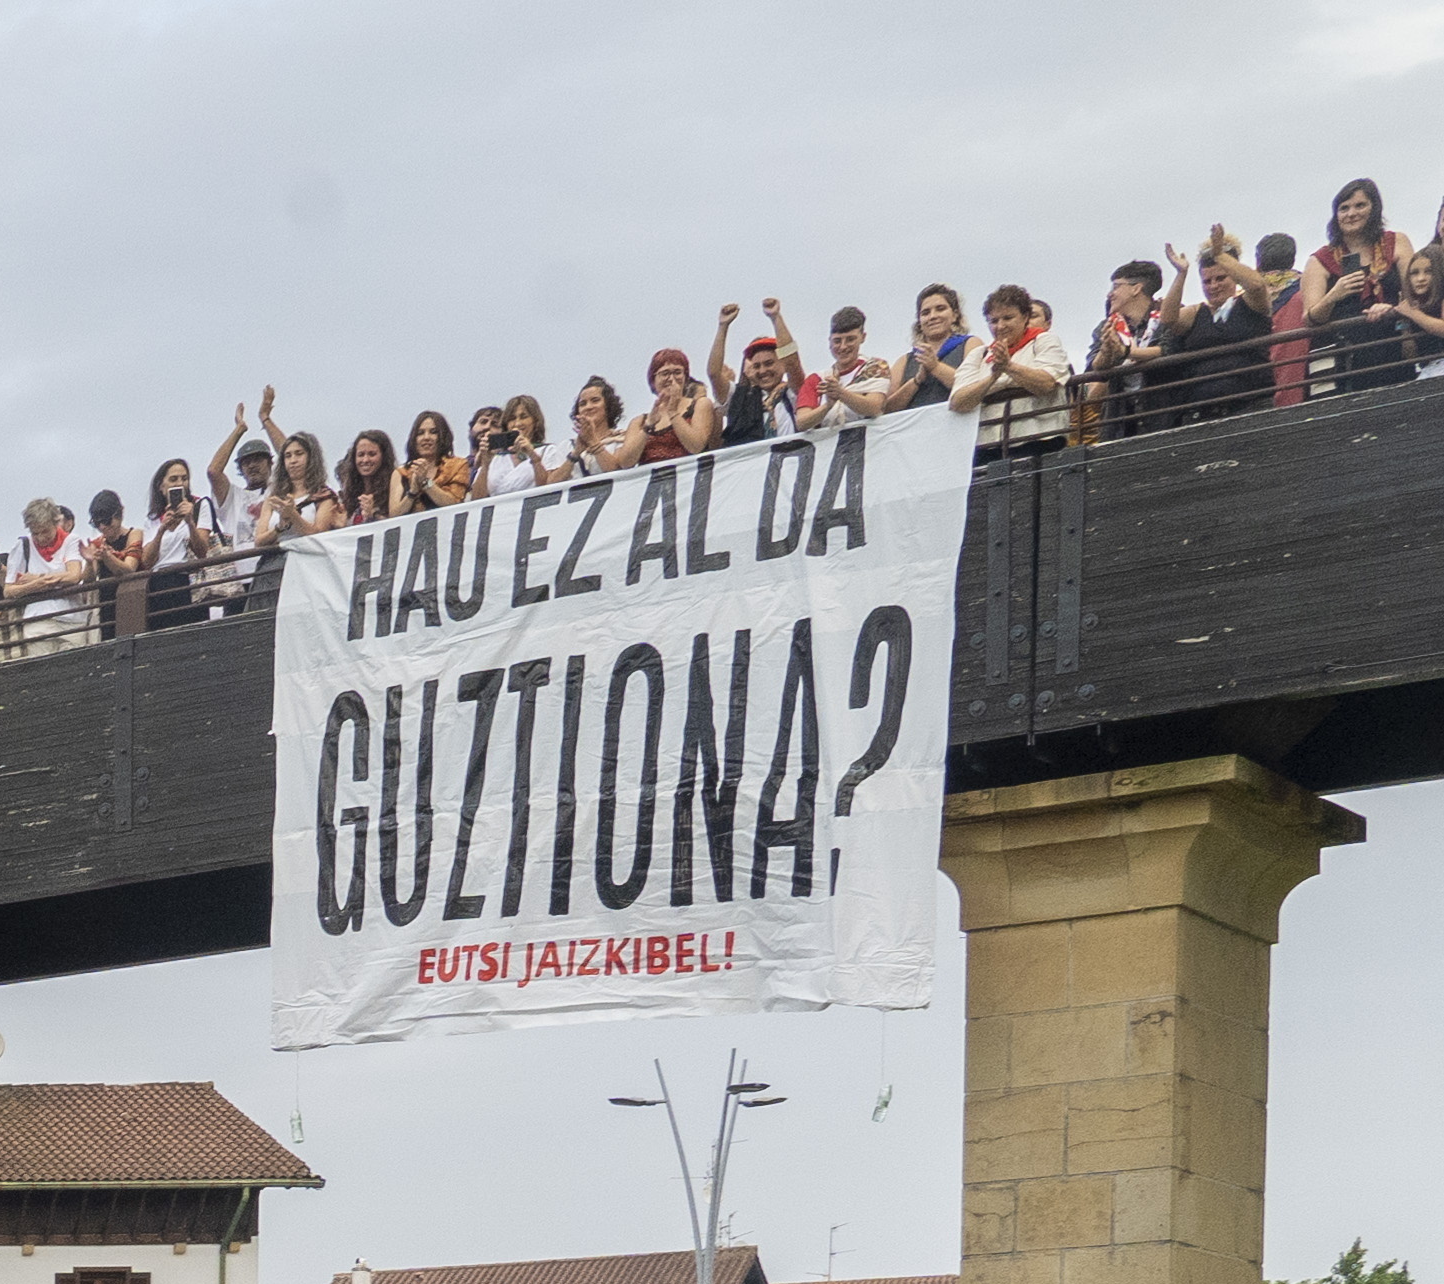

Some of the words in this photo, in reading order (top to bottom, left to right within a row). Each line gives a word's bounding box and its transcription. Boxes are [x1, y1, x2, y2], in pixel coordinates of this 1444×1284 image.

[347, 505, 495, 641] HAU
[511, 480, 614, 608] EZ
[626, 454, 731, 585] AL
[756, 427, 867, 561] DA
[317, 605, 912, 935] GUZTIONA?
[418, 940, 510, 985] EUTSI
[517, 931, 736, 987] JAIZKIBEL!
